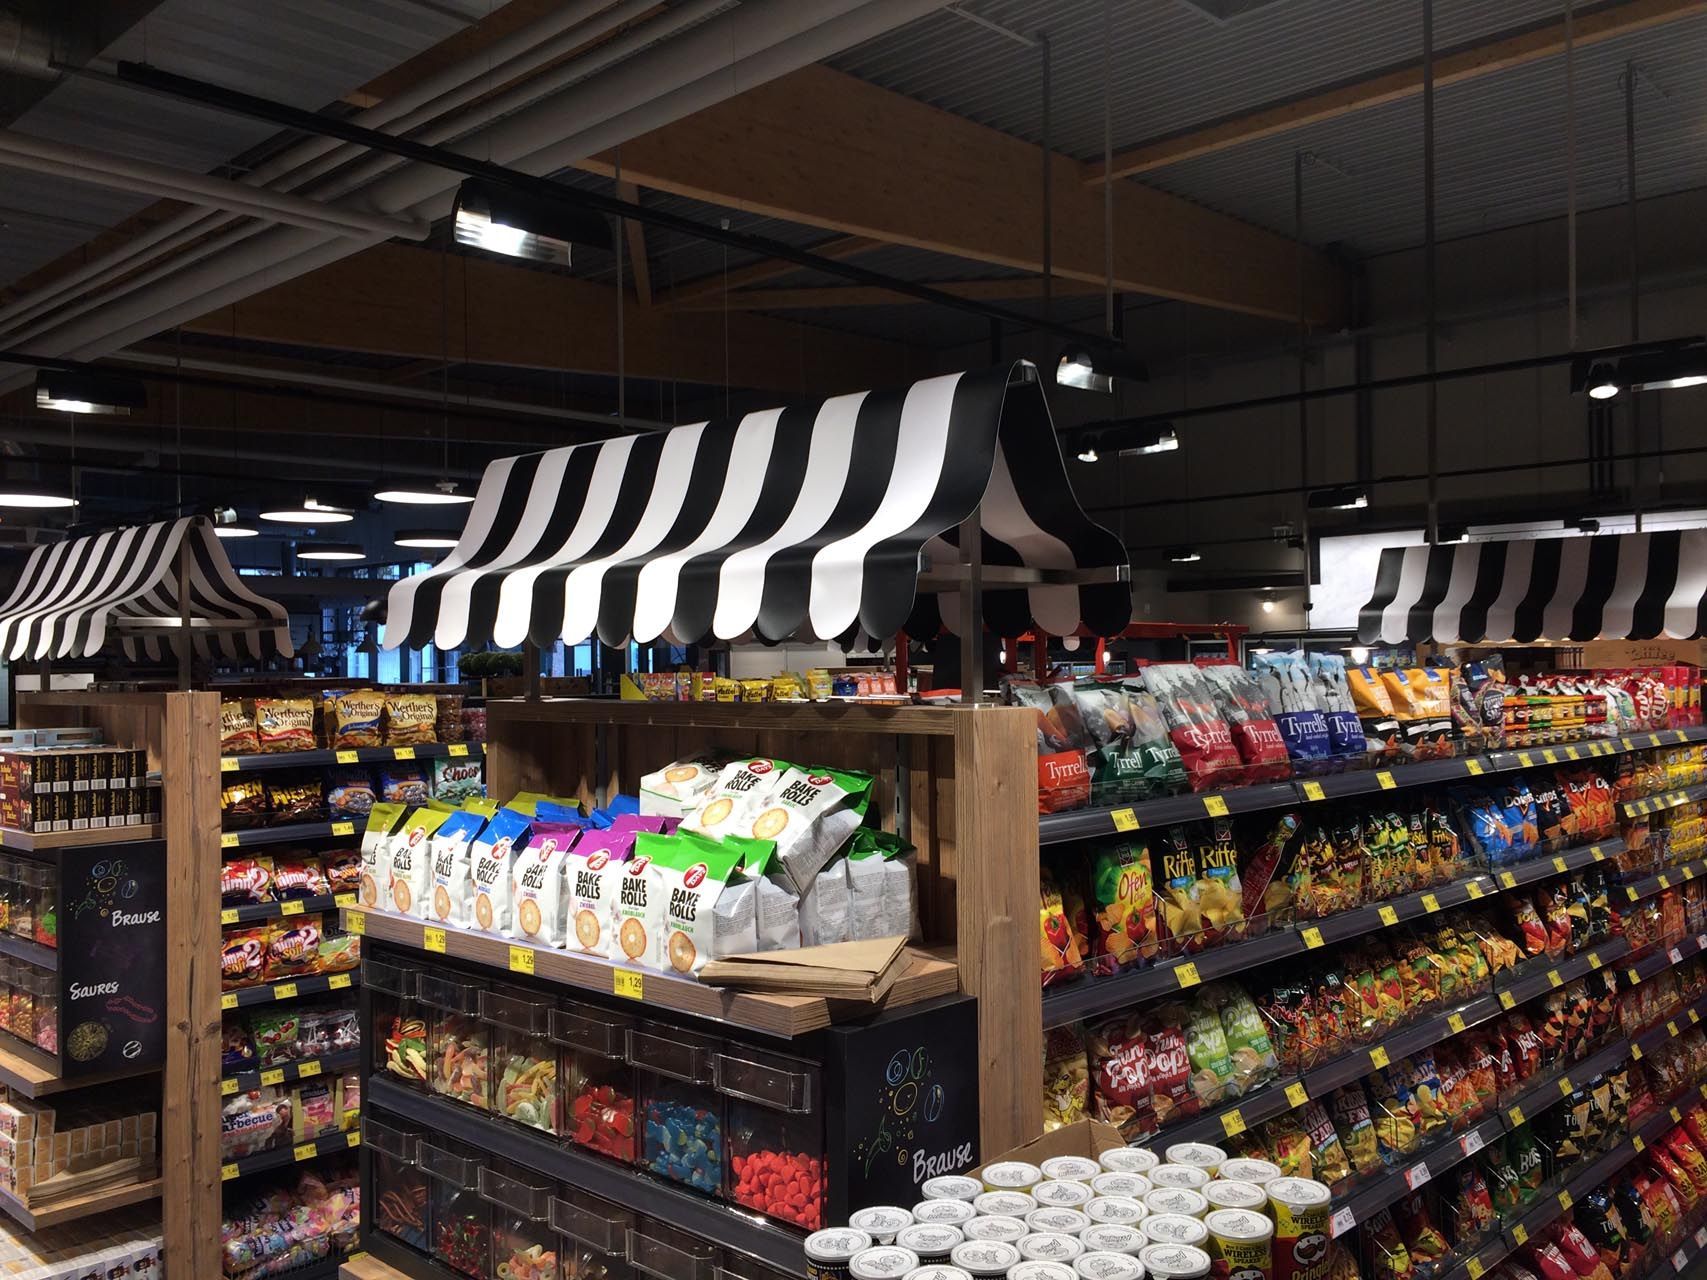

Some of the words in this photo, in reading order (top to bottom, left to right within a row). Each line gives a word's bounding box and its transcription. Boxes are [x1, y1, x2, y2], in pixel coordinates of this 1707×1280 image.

[261, 708, 313, 720] Werther's
[340, 701, 381, 713] Werther's
[351, 709, 380, 718] Original
[387, 702, 434, 714] Werther's
[401, 710, 434, 722] Original
[277, 719, 312, 731] Original
[1281, 713, 1329, 744] Tyrrell's
[725, 779, 754, 792] ROLLS
[789, 780, 821, 799] BAKE
[780, 788, 814, 807] ROLLS
[394, 857, 412, 871] ROLLS
[577, 870, 602, 887] BAKE
[622, 877, 647, 894] BAKE
[575, 883, 601, 900] ROLLS
[1118, 871, 1148, 905] Ofen
[620, 890, 647, 908] ROLLS
[671, 887, 701, 908] BAKE
[669, 901, 697, 922] ROLLS
[283, 943, 304, 960] soft
[522, 953, 534, 966] 1.29
[225, 957, 246, 976] soft
